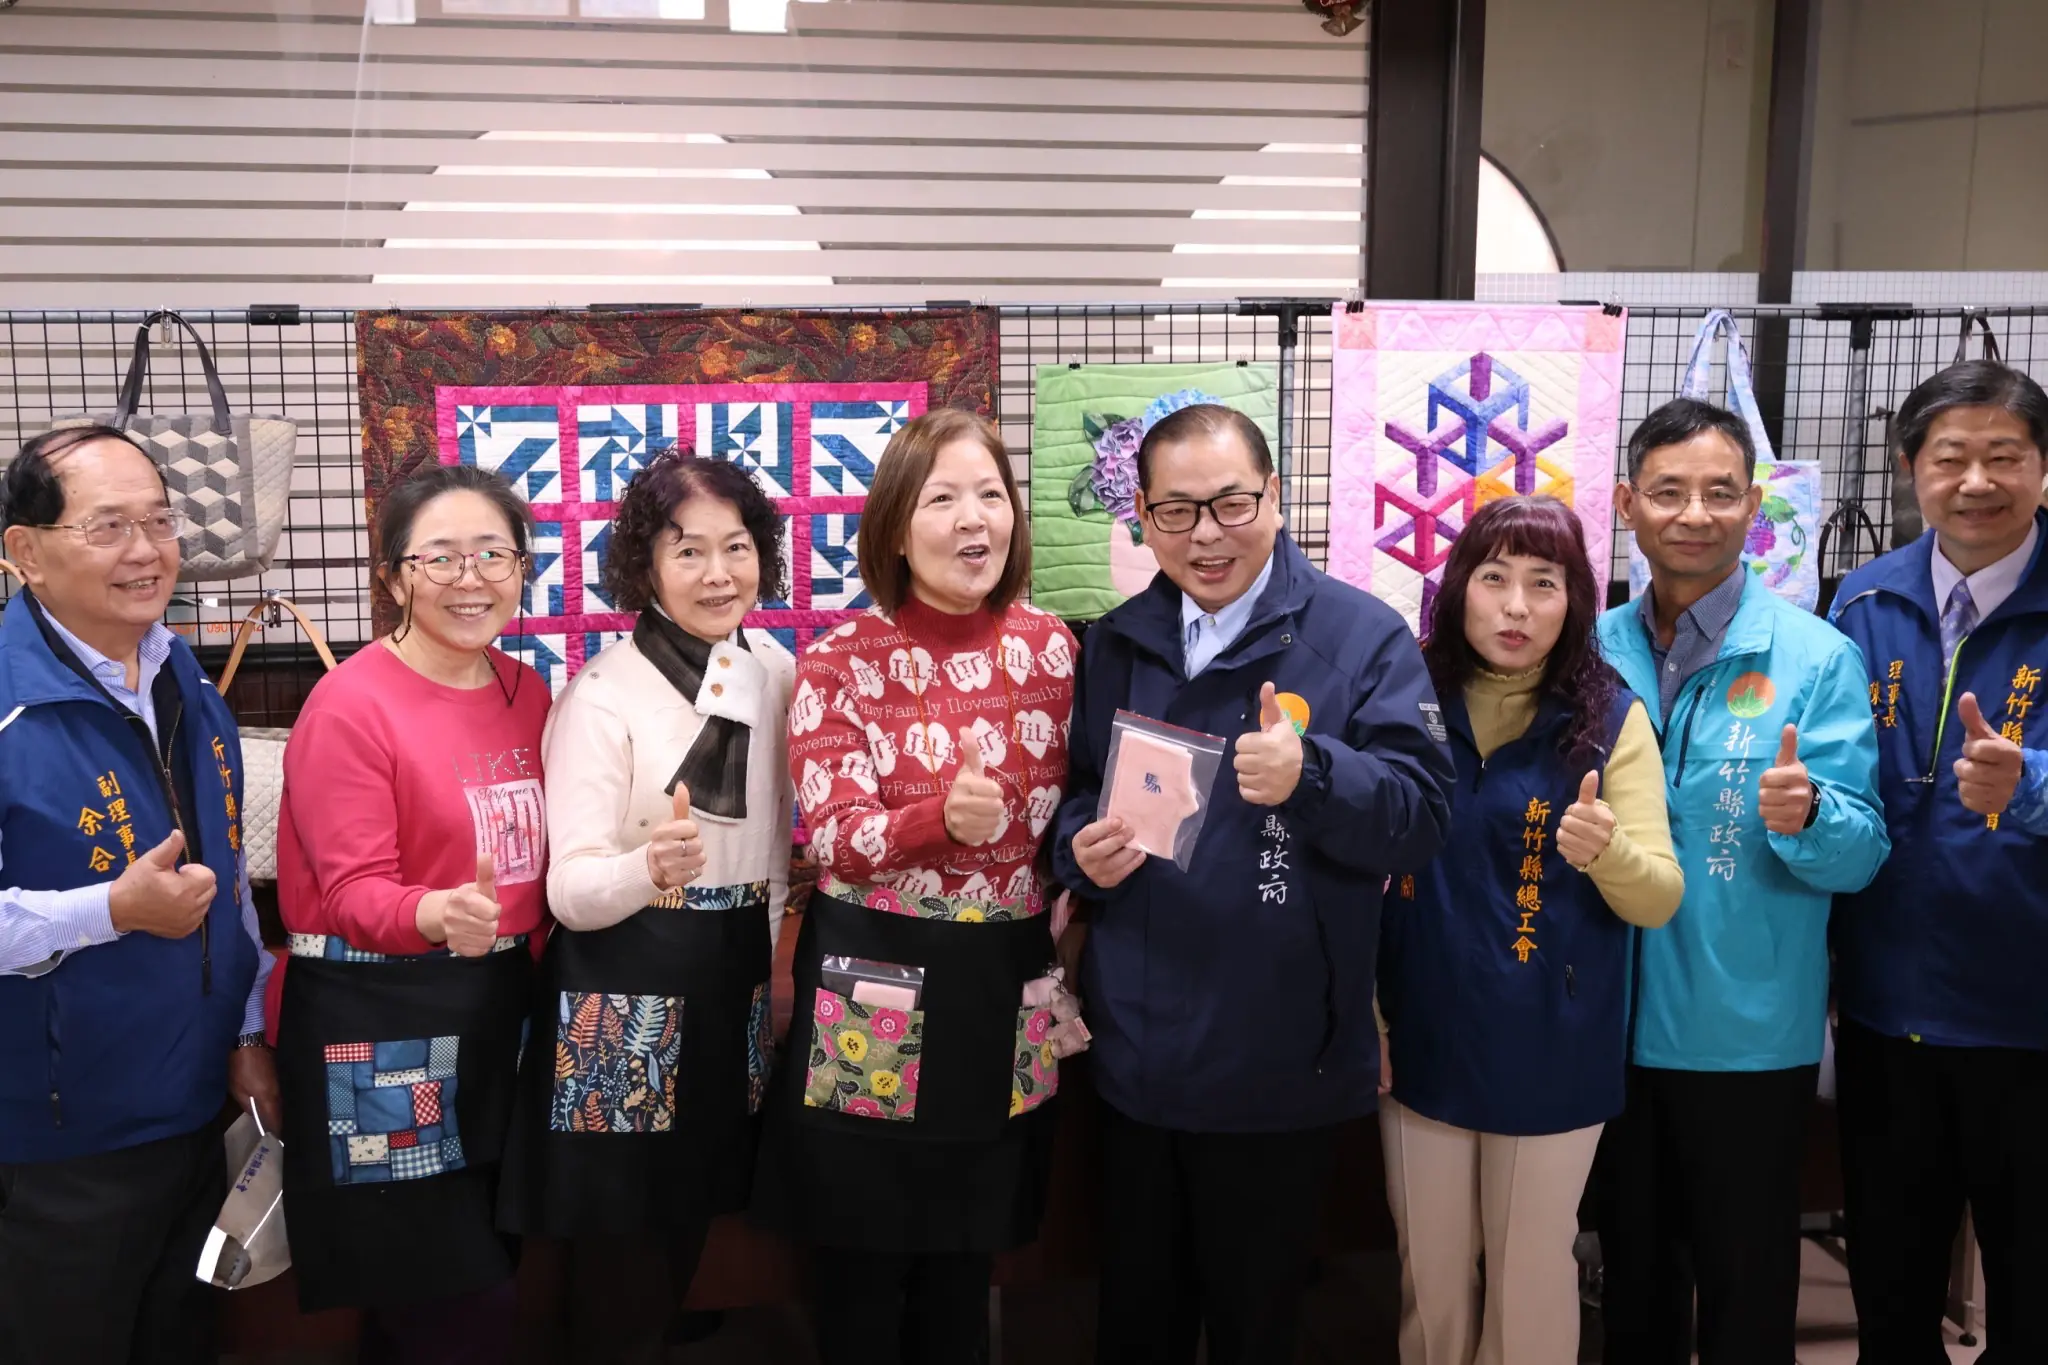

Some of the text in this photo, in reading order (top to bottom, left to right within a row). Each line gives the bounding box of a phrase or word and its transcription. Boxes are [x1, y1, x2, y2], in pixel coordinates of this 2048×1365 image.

[1883, 660, 1905, 729] 理事長
[451, 748, 538, 784] LIKE
[1144, 772, 1162, 795] 馬
[1705, 720, 1757, 882] 新竹縣政府
[1258, 814, 1291, 905] 縣政府
[1511, 797, 1552, 964] 新竹縣總工會
